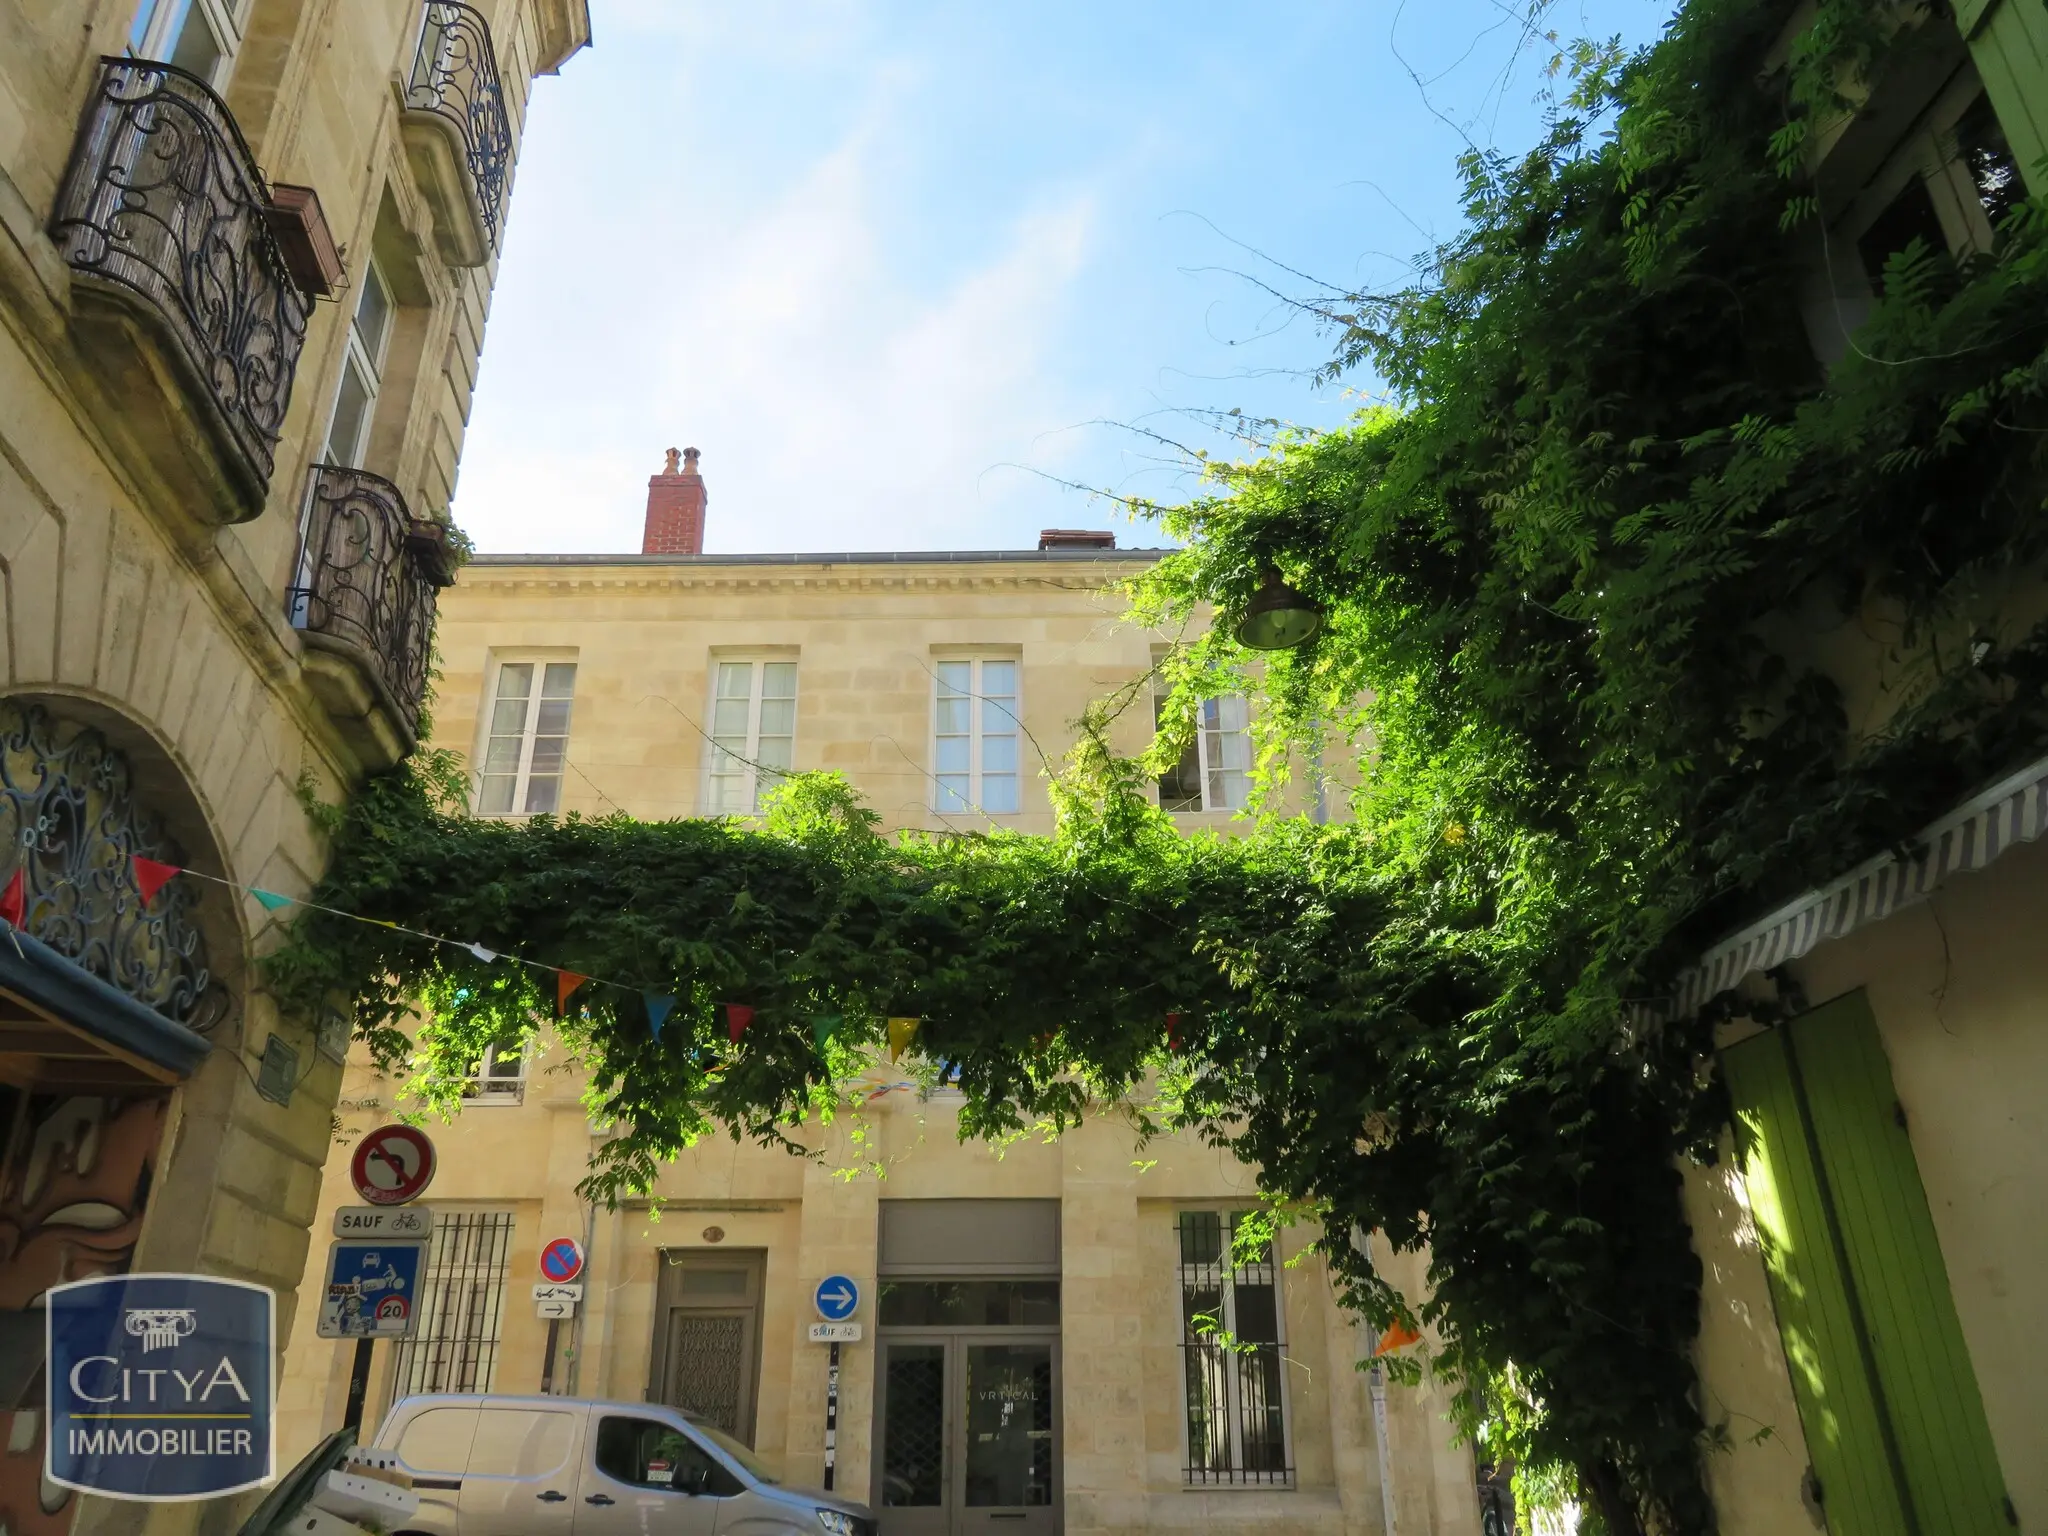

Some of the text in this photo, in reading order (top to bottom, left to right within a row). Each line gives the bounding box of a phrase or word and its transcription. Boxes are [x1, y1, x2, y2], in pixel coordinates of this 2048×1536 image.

[342, 1215, 384, 1229] SAUF
[383, 1305, 402, 1318] 20
[979, 1391, 1039, 1401] VRTICAL
